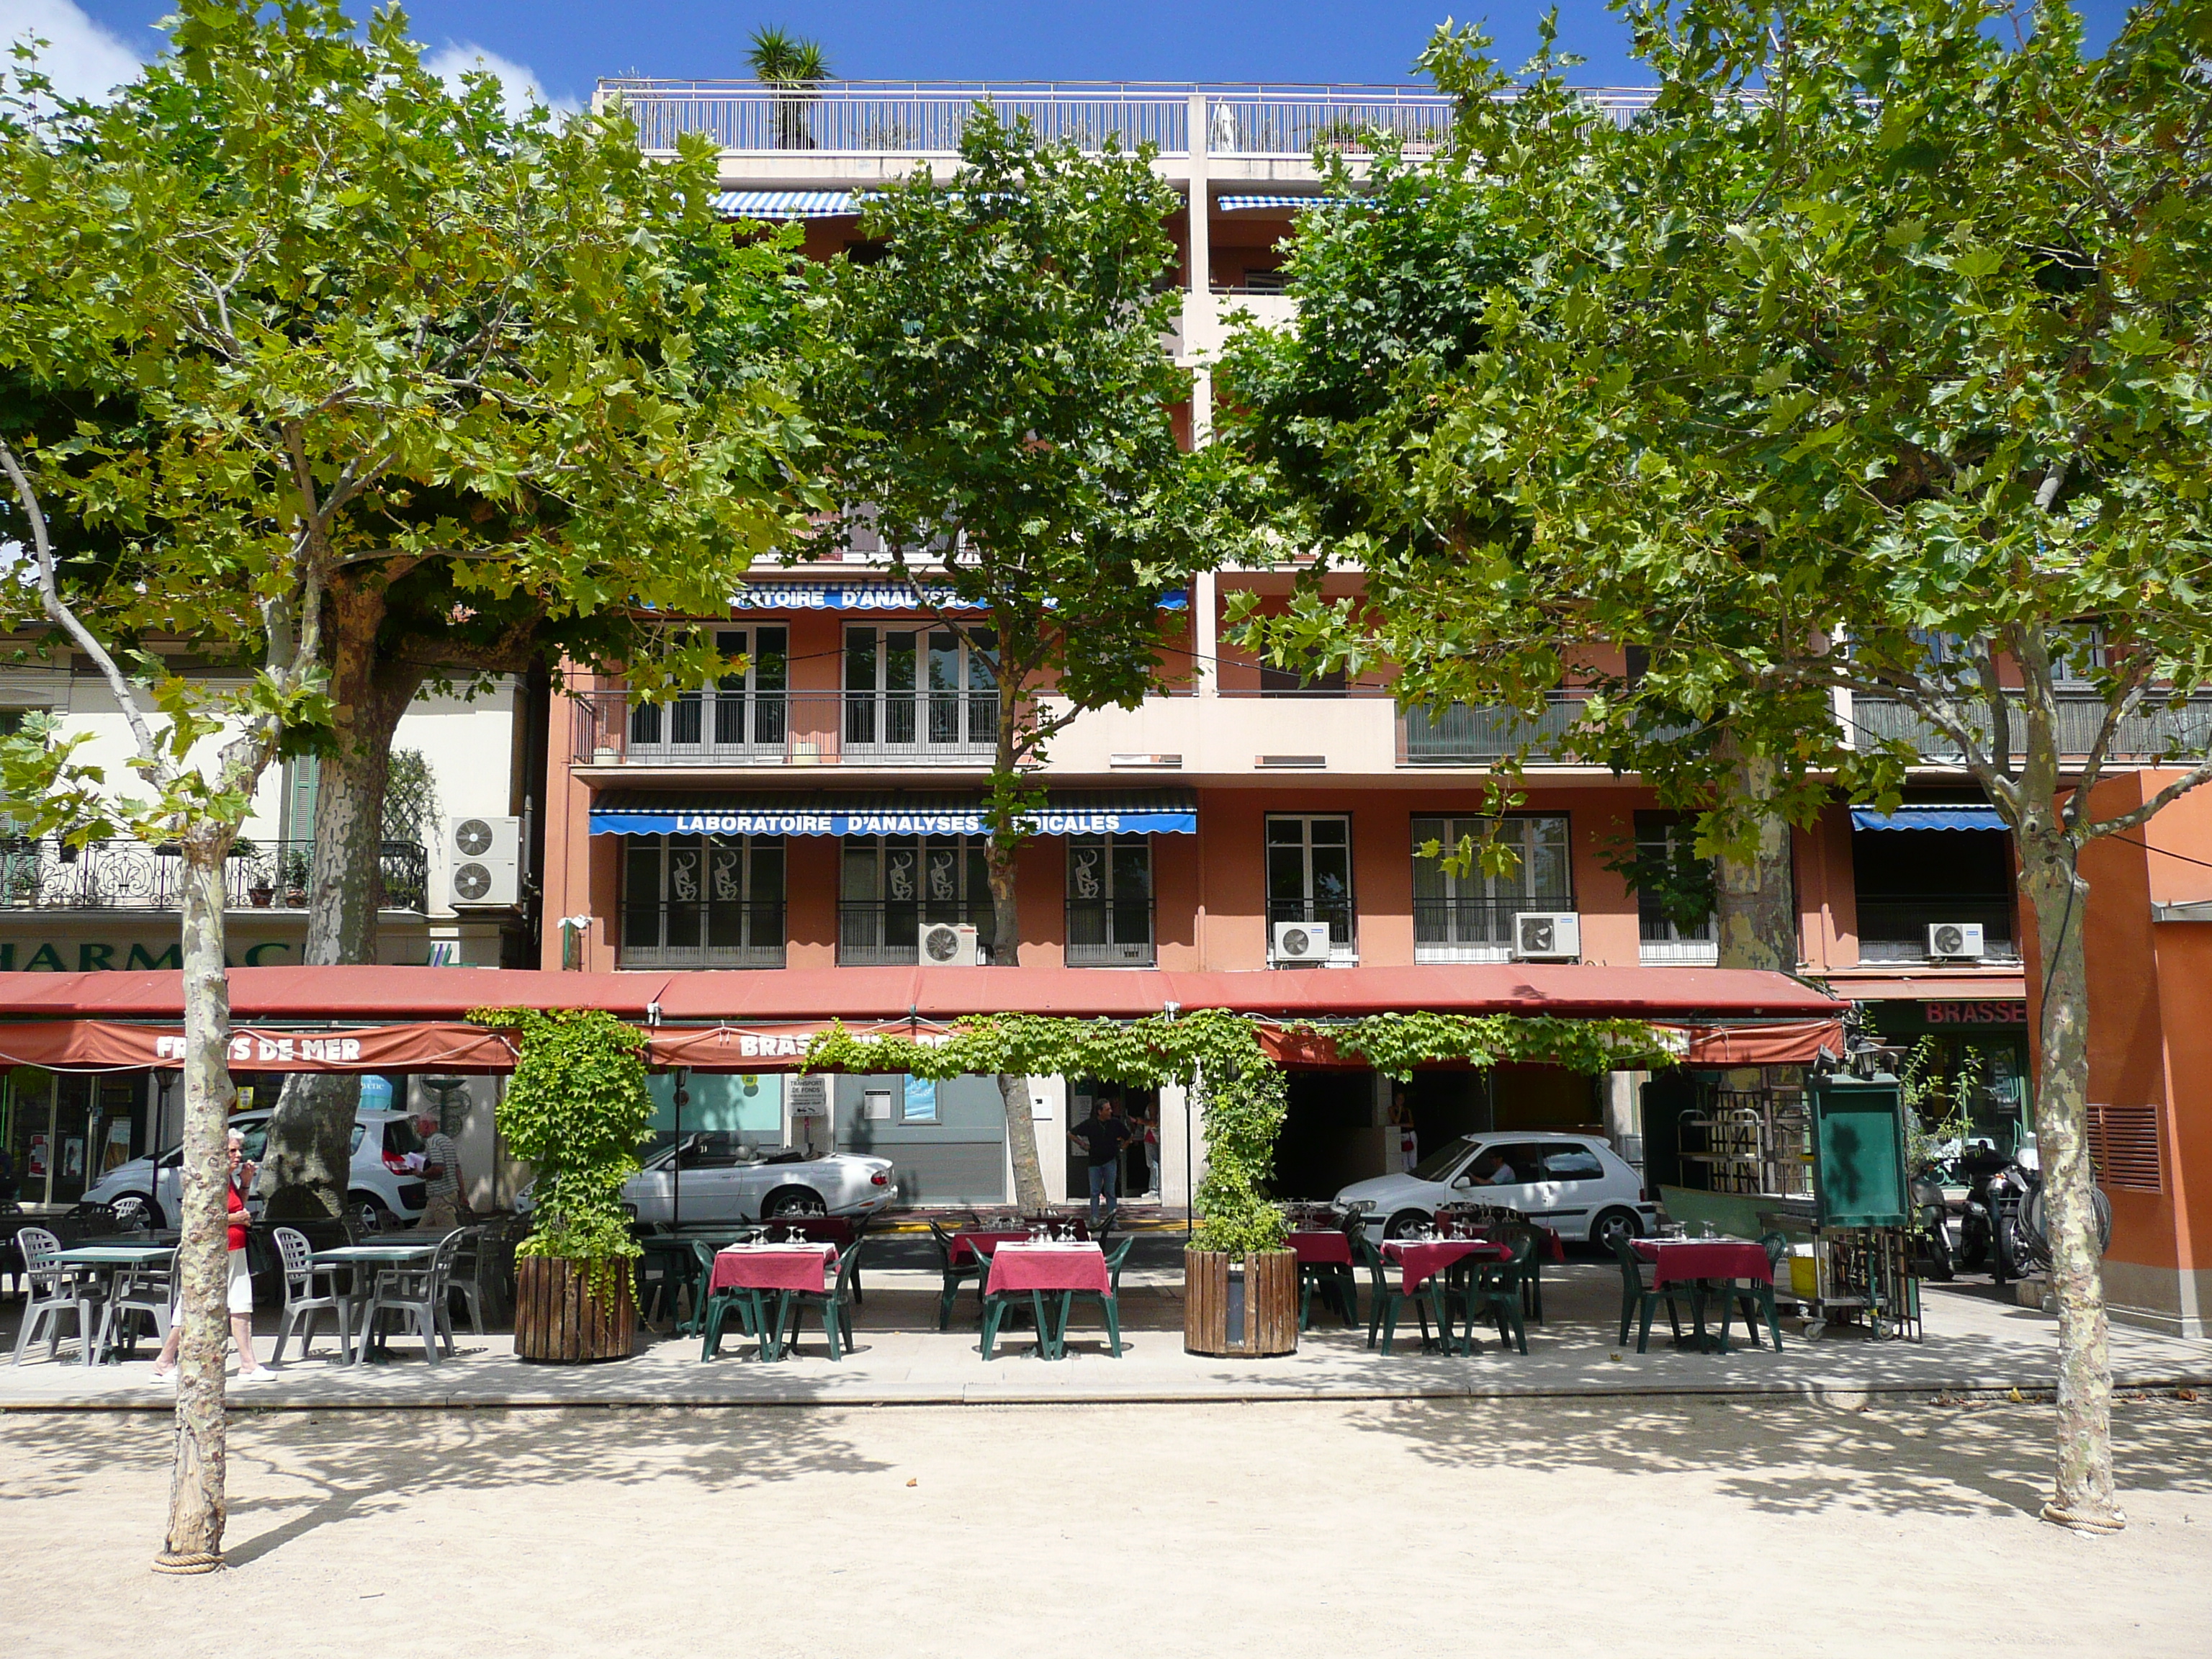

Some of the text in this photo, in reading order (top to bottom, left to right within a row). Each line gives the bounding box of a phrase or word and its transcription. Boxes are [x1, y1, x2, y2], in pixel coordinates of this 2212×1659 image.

[677, 815, 832, 832] LABORATOIRE
[848, 815, 979, 831] D'ANALYSES
[258, 1038, 294, 1061] DE
[301, 1038, 360, 1061] MER
